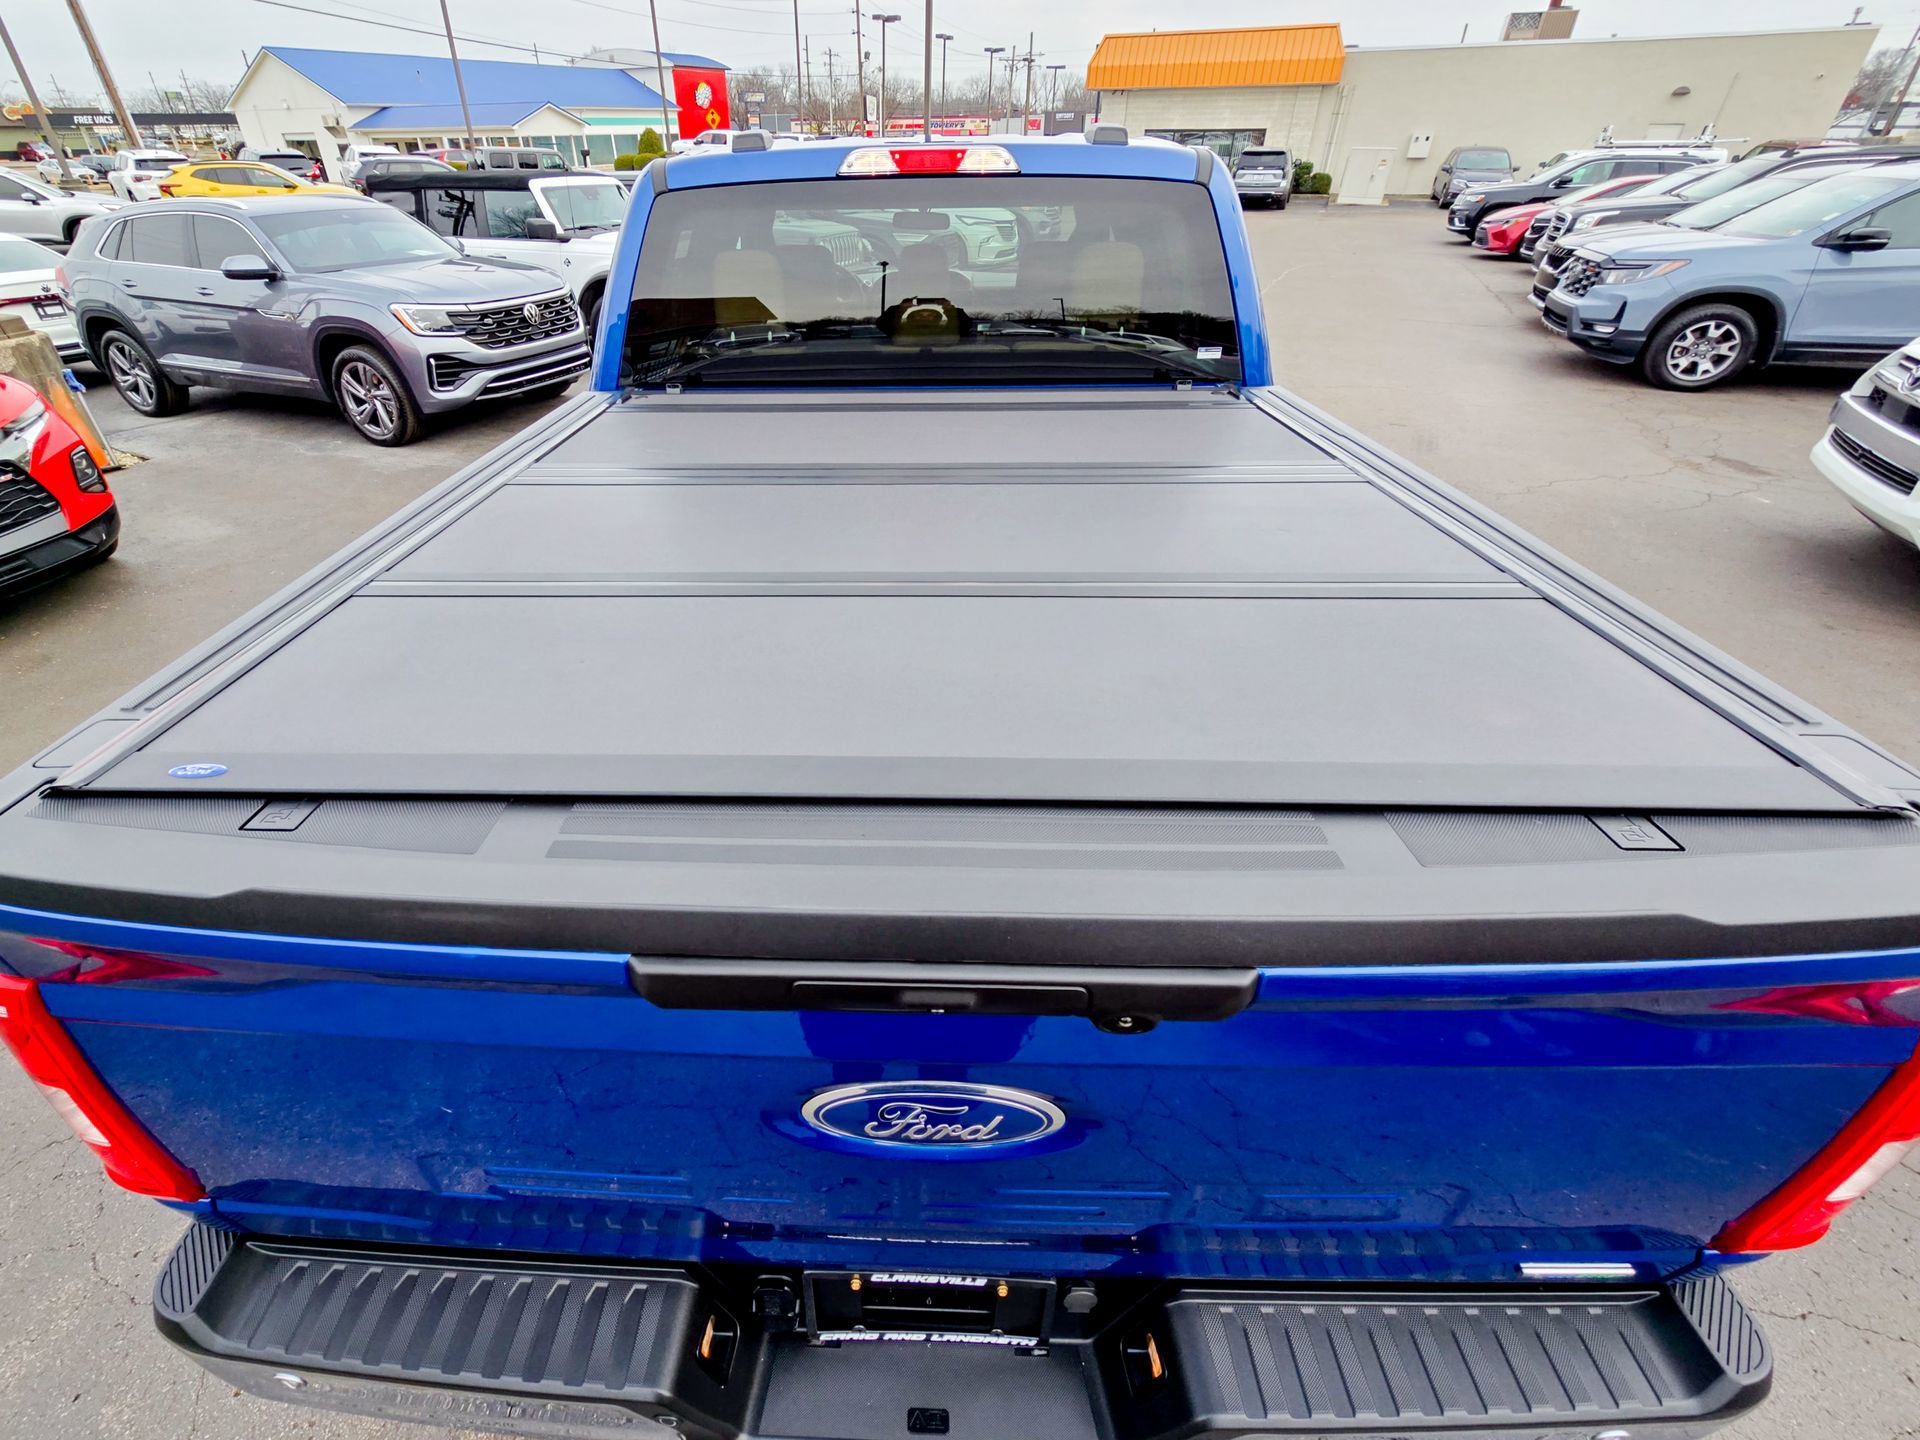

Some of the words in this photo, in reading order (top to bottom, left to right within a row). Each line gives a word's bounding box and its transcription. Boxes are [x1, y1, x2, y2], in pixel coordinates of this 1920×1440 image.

[73, 115, 94, 124] FREE
[94, 115, 114, 124] VACS
[864, 1101, 1004, 1140] Ford
[870, 1273, 988, 1287] CLARKSVILLE
[882, 1333, 927, 1341] AND
